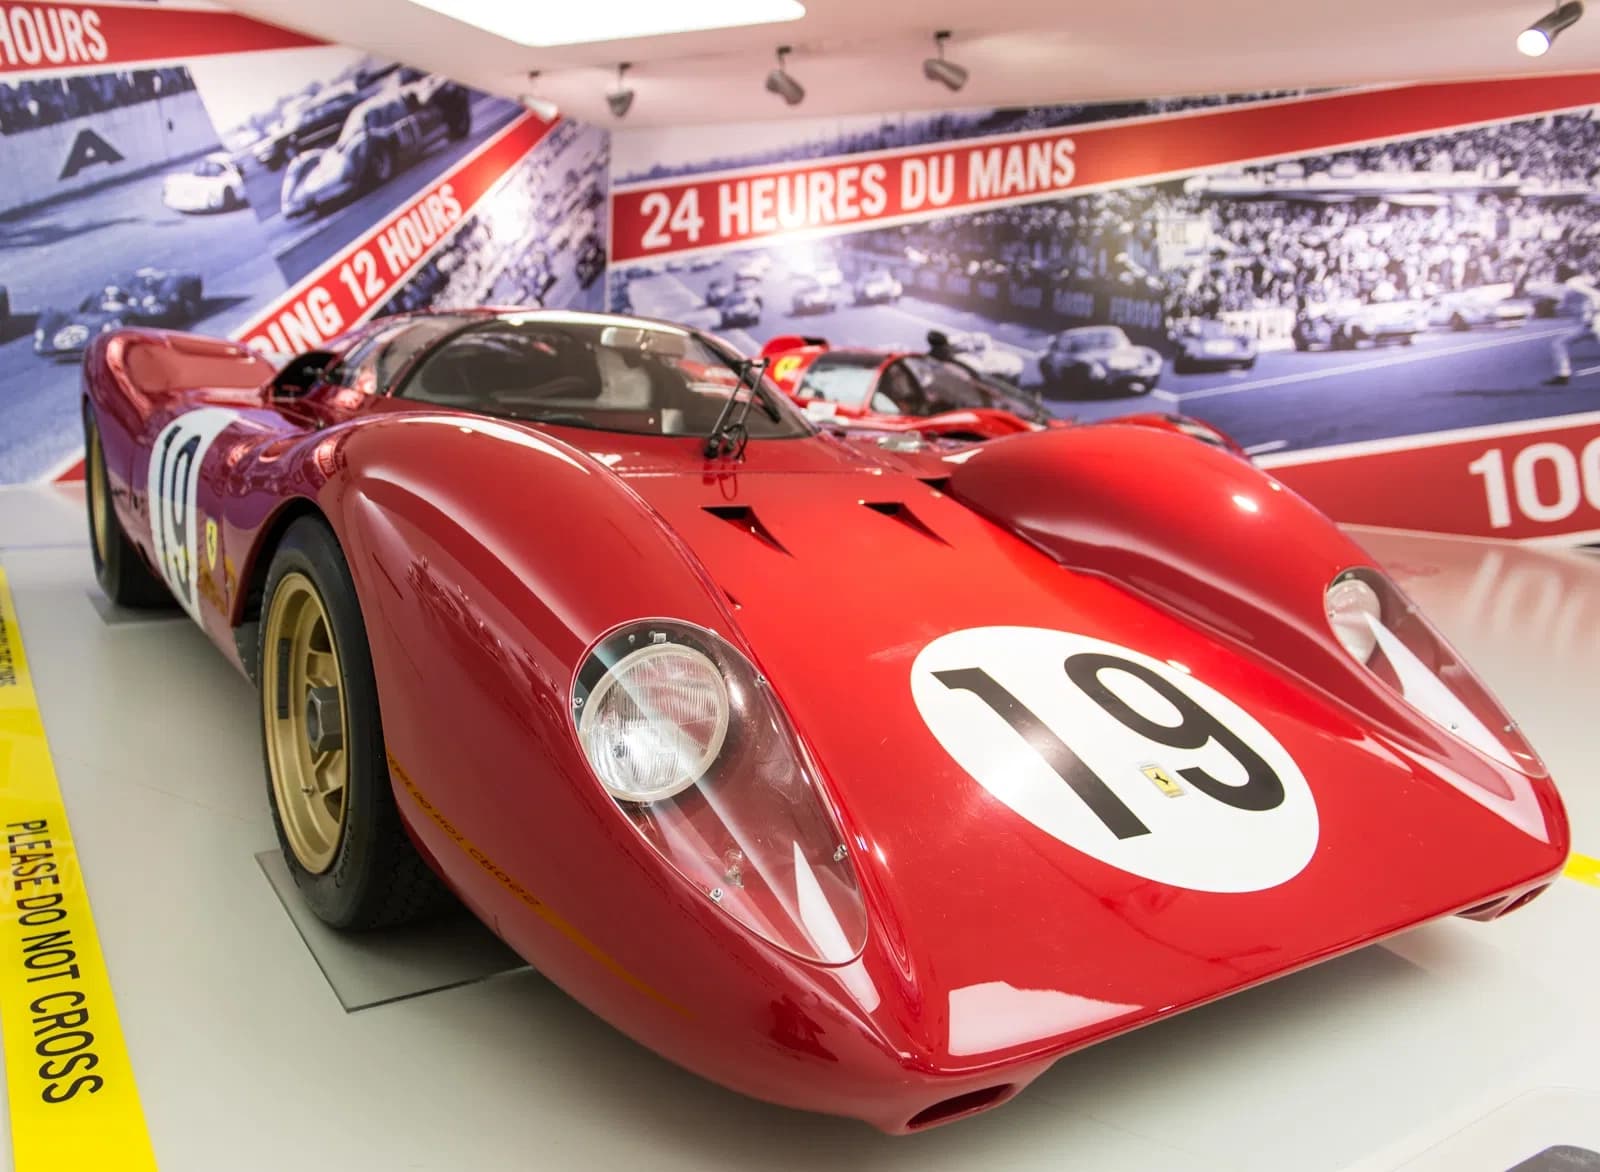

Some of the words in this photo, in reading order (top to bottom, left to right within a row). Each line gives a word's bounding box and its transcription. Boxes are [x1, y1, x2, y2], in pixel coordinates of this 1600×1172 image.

[58, 129, 125, 181] A
[639, 188, 703, 249] 24
[718, 163, 888, 236] HEURES
[900, 154, 955, 210] DU
[968, 138, 1076, 200] MANS
[340, 250, 385, 308] 12
[377, 183, 462, 276] HOURS
[159, 425, 202, 604] 19
[931, 652, 1286, 840] 19
[6, 819, 61, 891] PLEASE
[16, 893, 68, 926] DO
[21, 930, 81, 983] NOT
[29, 991, 104, 1104] CROSS
